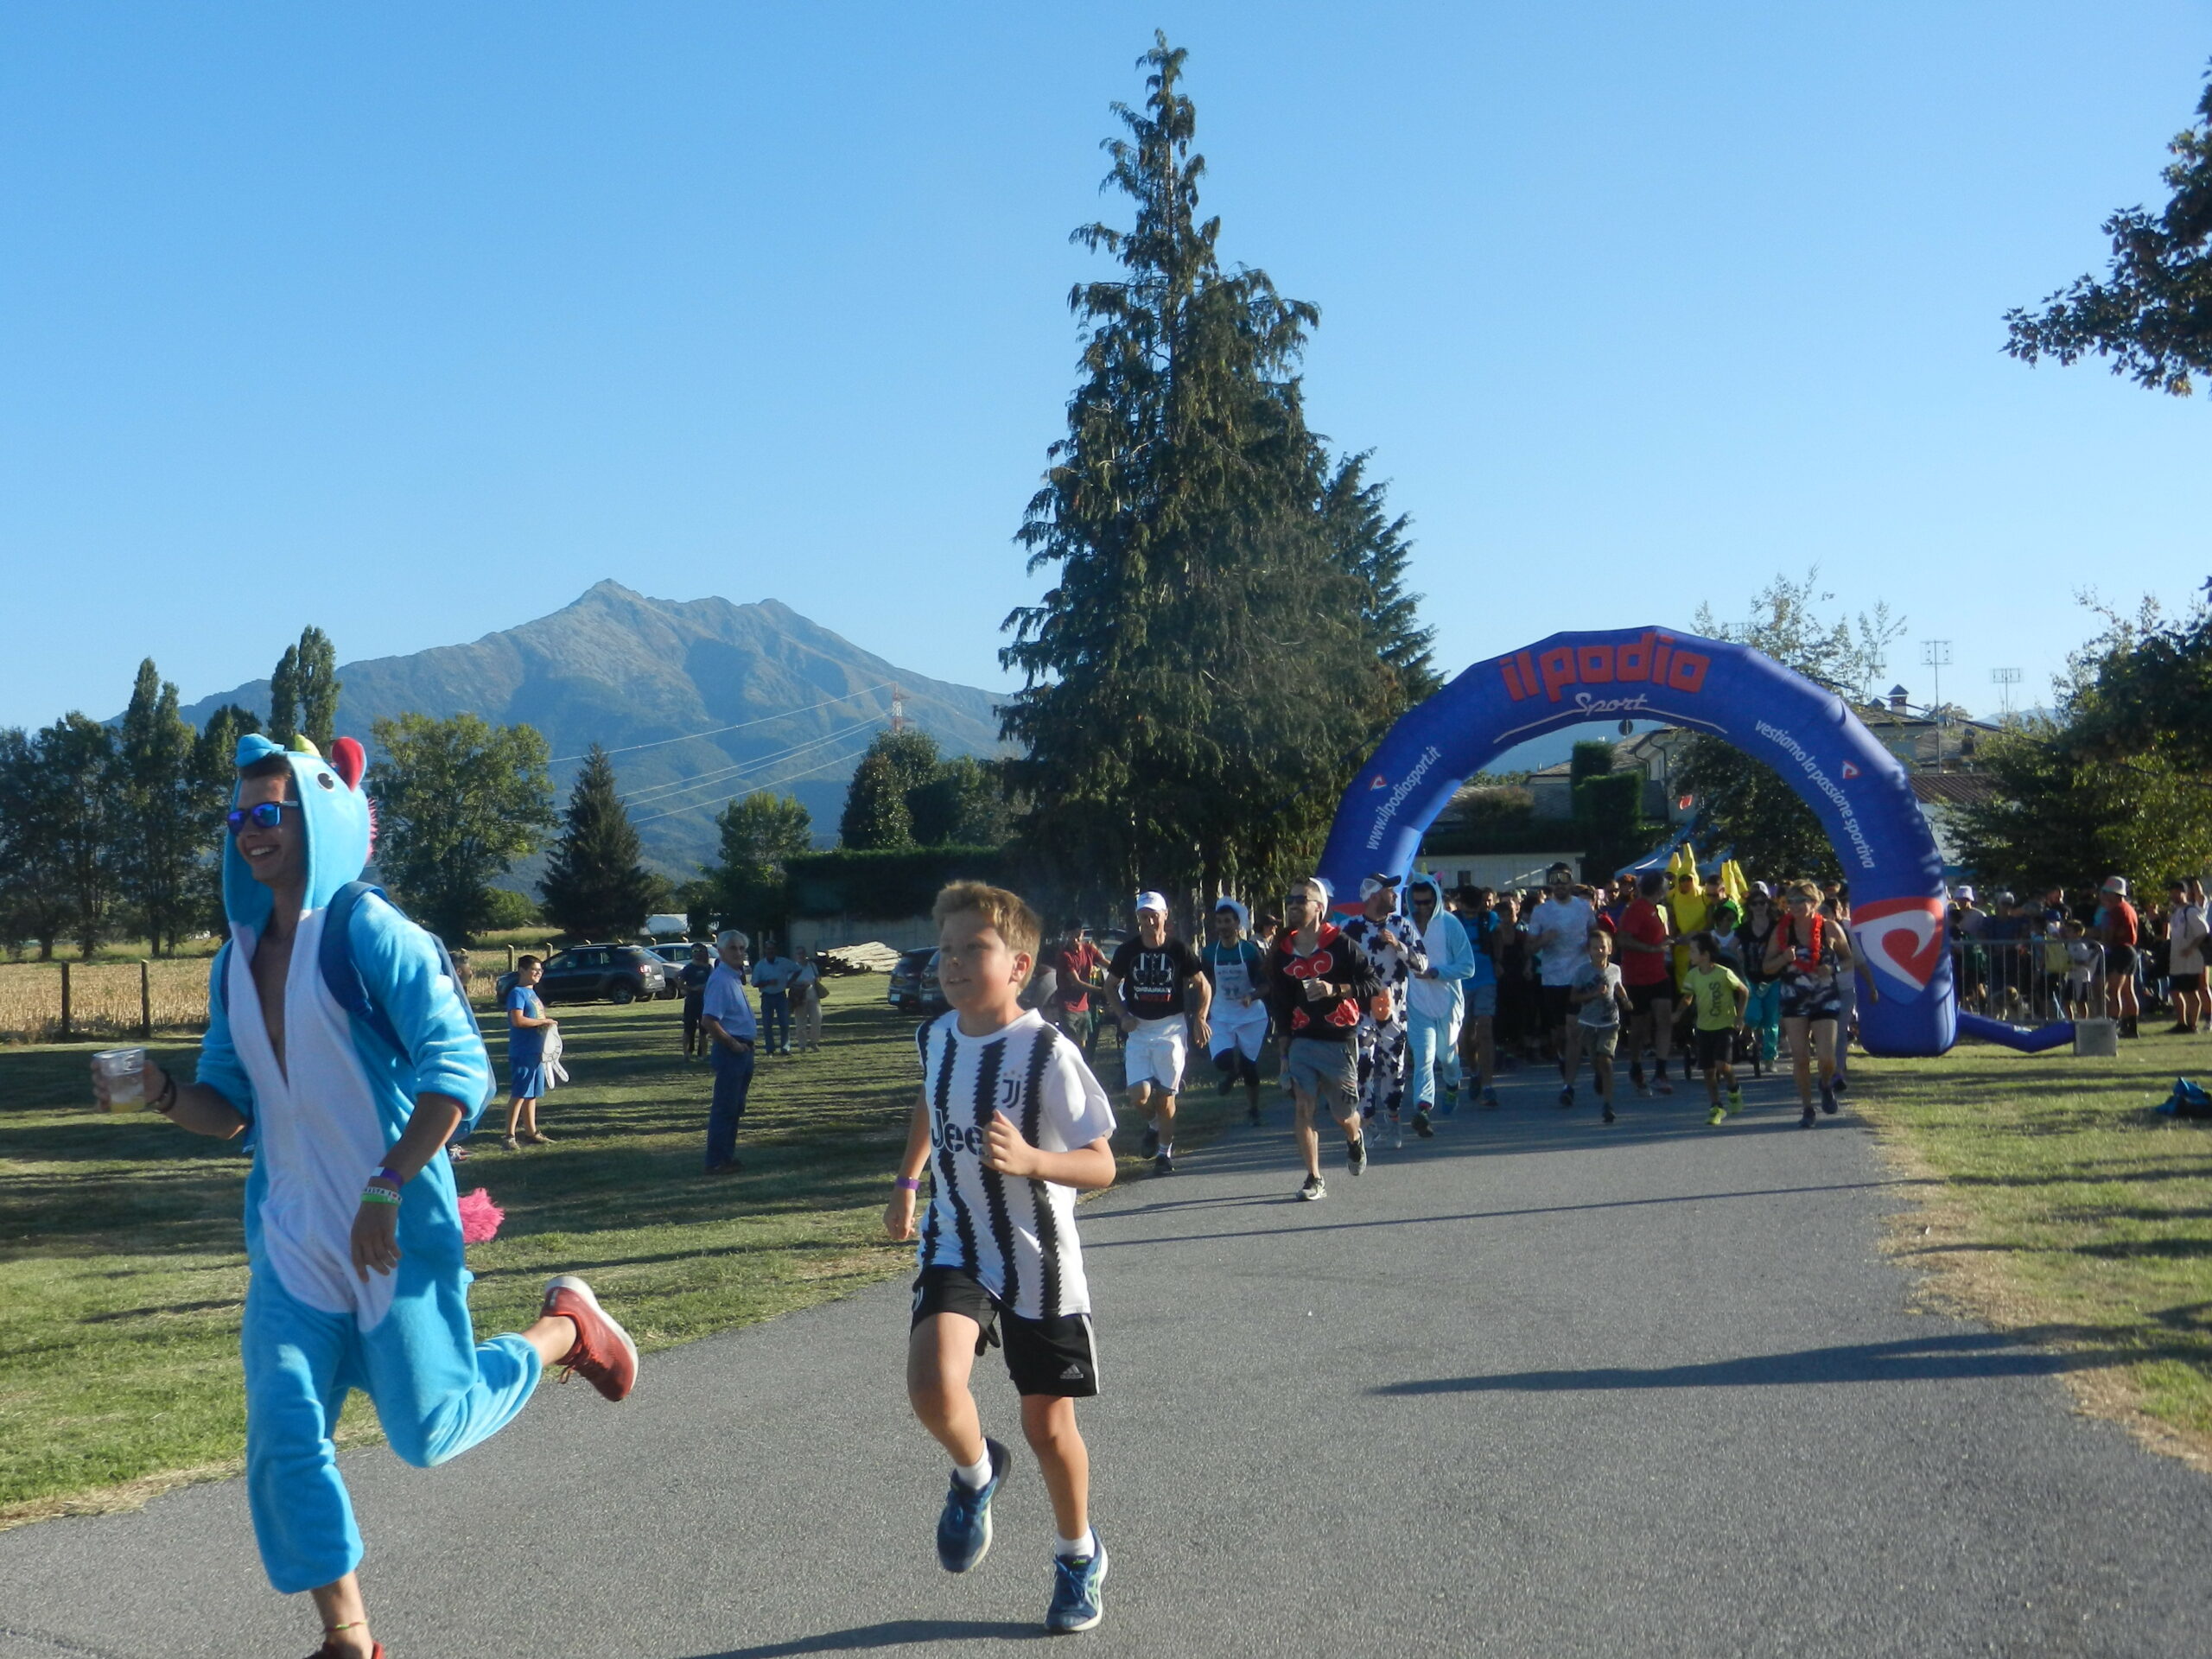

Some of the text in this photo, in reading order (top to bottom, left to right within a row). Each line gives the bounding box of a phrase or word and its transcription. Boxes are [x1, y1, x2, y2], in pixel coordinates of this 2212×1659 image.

[1575, 692, 1648, 716] Sport
[1367, 746, 1441, 850] www.ilpodiosport.it
[1755, 720, 1875, 868] vestiamo la passione sportiva
[931, 1109, 983, 1155] Jee
